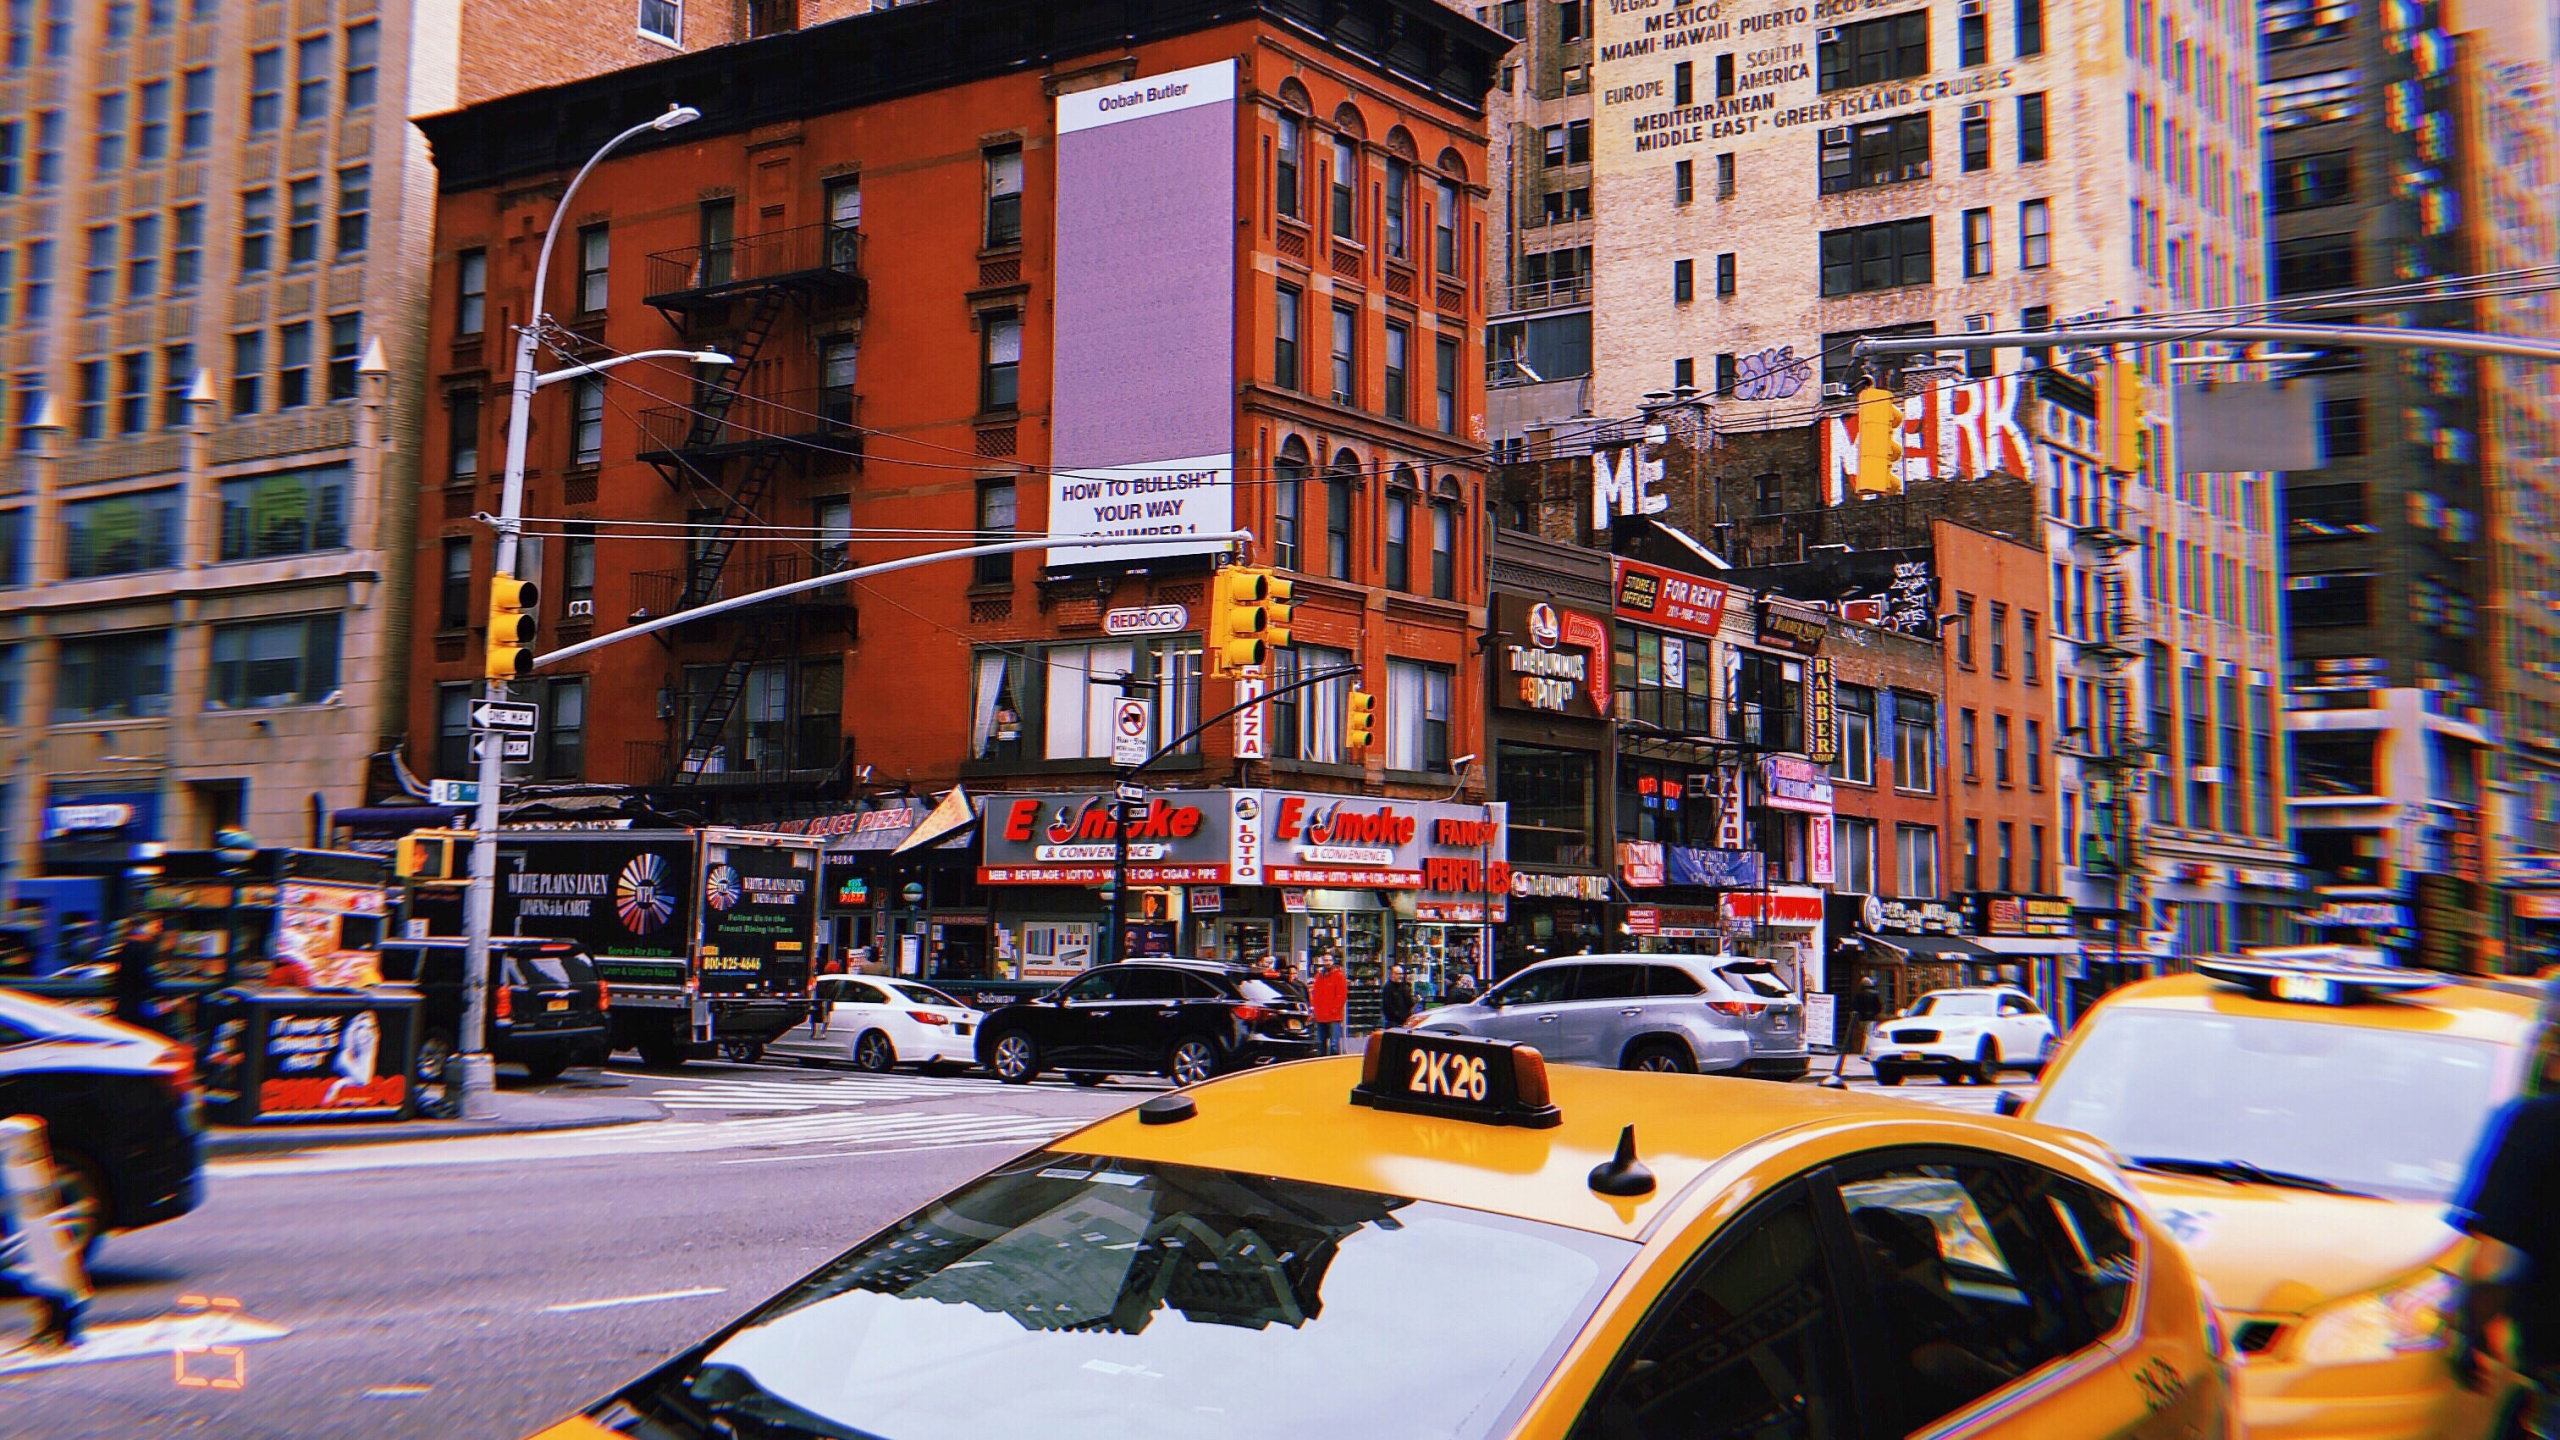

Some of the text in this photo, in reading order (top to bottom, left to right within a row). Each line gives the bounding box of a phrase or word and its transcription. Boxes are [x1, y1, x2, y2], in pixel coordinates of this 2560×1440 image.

[1645, 3, 1721, 33] MEXICO
[1740, 7, 1808, 35] PUERTO
[1746, 42, 1805, 68] SOUTH
[1737, 63, 1811, 92] AMERICA
[1098, 82, 1190, 112] Oobah Butler
[1604, 80, 1664, 106] EUROPE
[1633, 92, 1776, 133] MEDITERRANEAN
[1636, 69, 2015, 152] MIDDLE EAST GREEK ISLAND CRUISES
[1062, 482, 1102, 501] HOW
[1105, 480, 1129, 497] TO
[1094, 499, 1184, 522] YOUR WAY
[1625, 575, 1657, 593] STORE &
[1663, 578, 1723, 610] FOR RENT
[1621, 590, 1654, 609] OFFICES
[1110, 611, 1180, 628] REDROCK
[488, 711, 531, 722] ONE WAY
[1243, 669, 1258, 753] PIZZA
[1815, 659, 1829, 753] BARBER
[507, 743, 526, 752] WAY
[1811, 753, 1835, 762] SHOP
[448, 783, 460, 800] 8
[806, 813, 857, 837] SLICE
[856, 808, 913, 832] PIZZA
[1004, 799, 1039, 841] E
[1278, 797, 1305, 839] E
[1436, 819, 1499, 847] FANCY
[1045, 845, 1153, 858] & CONVENNCE
[1239, 824, 1256, 876] LOTTO
[1310, 846, 1387, 862] & CONVENIENCE
[540, 874, 576, 894] PLAINS
[577, 874, 609, 895] LINEN
[989, 869, 1008, 881] BEER
[1015, 869, 1060, 881] BEVERAGE
[1066, 869, 1094, 880] LOTTO
[1139, 869, 1153, 879] CIG
[1163, 869, 1190, 879] CIGAR
[1198, 869, 1217, 879] PIPE
[1328, 871, 1349, 882] LOTTO
[1352, 872, 1367, 882] VAPE
[1410, 874, 1422, 885] PIPE
[1426, 858, 1510, 893] PERFUES
[563, 900, 591, 917] CARTE
[1193, 893, 1220, 906] ATM
[1286, 894, 1305, 906] ATM
[976, 992, 1017, 1003] Subway
[1409, 1048, 1488, 1101] 2K26
